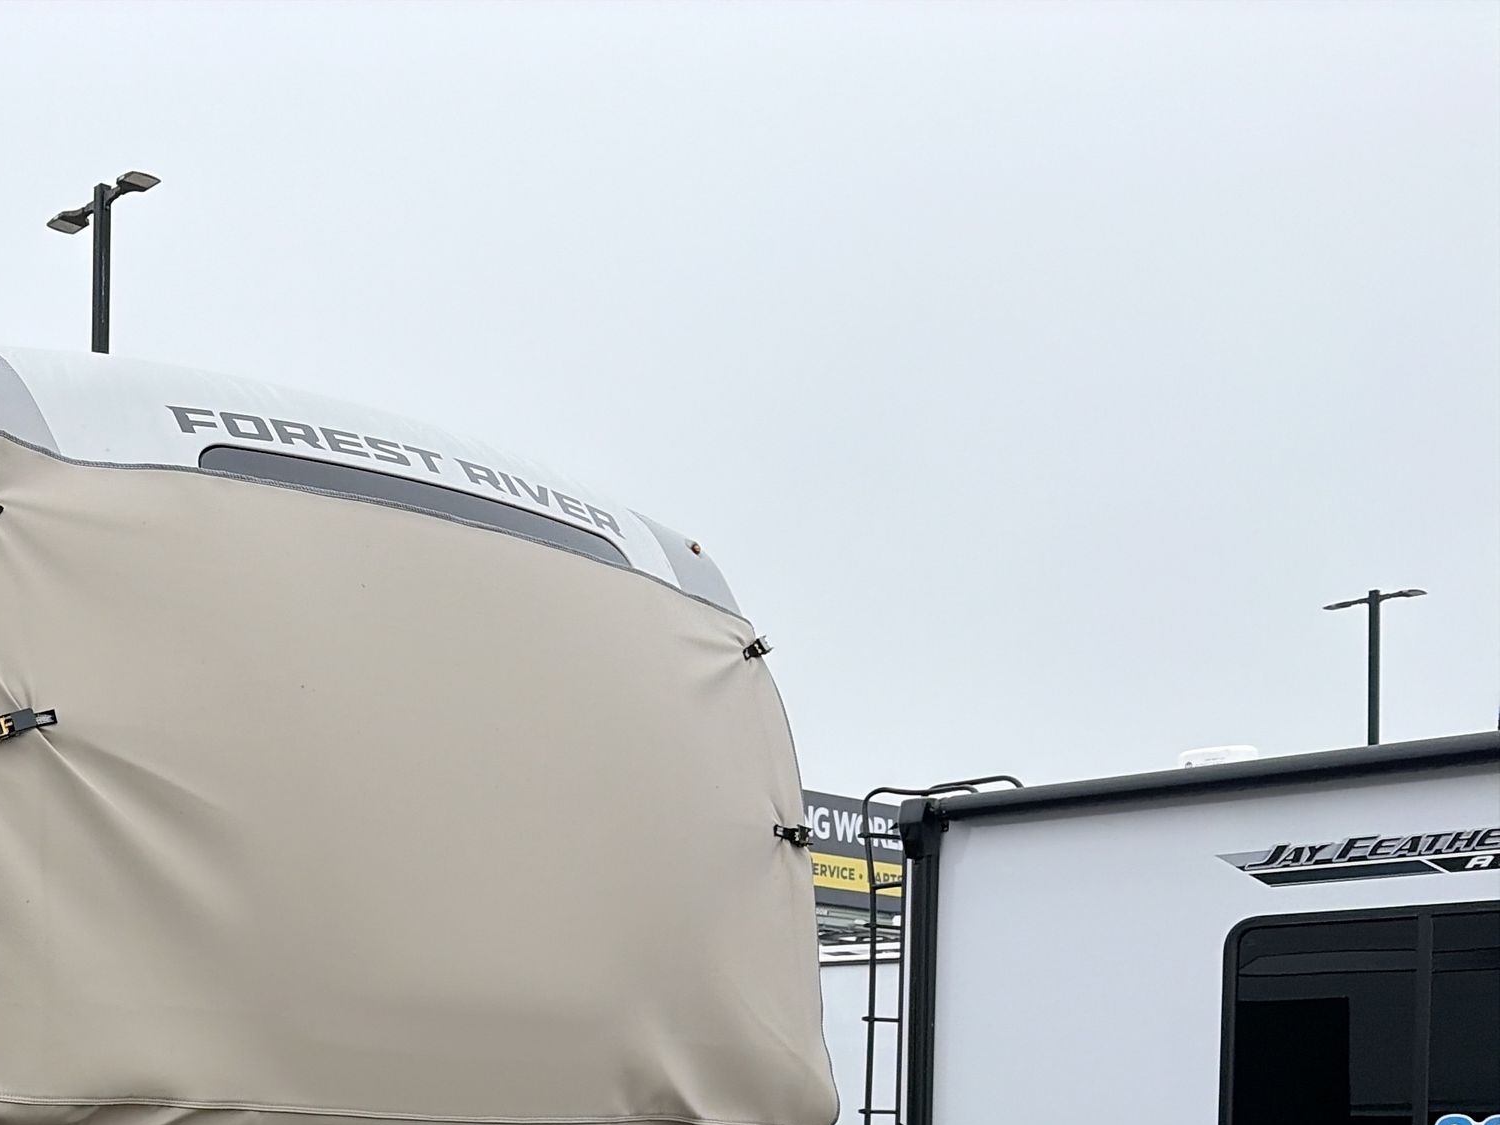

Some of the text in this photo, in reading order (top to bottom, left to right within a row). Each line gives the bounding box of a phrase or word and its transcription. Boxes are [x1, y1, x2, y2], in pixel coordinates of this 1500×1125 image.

[165, 405, 624, 538] FOREST RIVER
[1245, 844, 1330, 869] JAY
